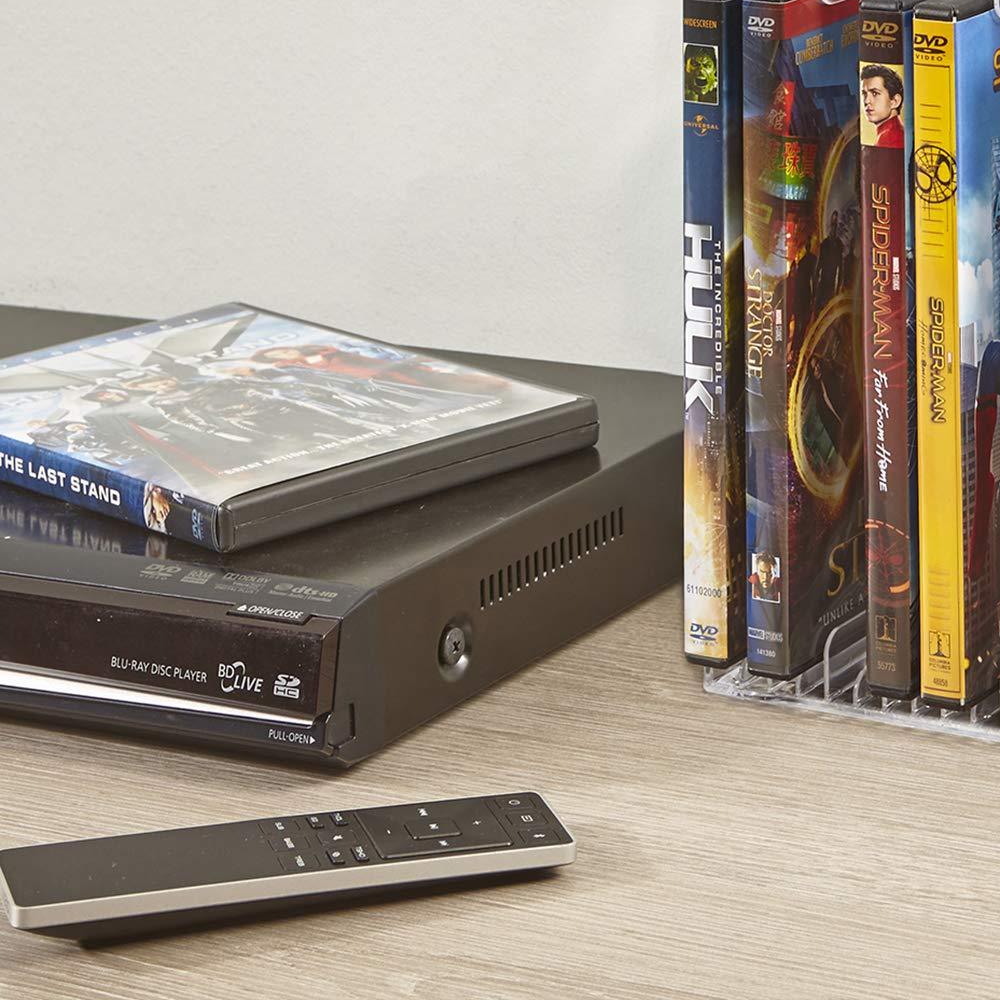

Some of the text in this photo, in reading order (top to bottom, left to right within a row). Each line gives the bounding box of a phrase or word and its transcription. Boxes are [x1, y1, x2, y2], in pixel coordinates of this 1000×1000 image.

[684, 18, 717, 29] WIDESCREEN
[748, 16, 775, 26] DVD
[862, 21, 899, 34] DVD
[865, 41, 893, 49] VIDEO
[914, 34, 947, 47] DVD
[871, 184, 892, 359] SPIDER-MAN
[684, 222, 713, 415] HULK
[747, 268, 763, 379] STRANGE
[762, 291, 773, 357] DOCTOR
[715, 283, 723, 395] INCREDIBLE
[928, 297, 946, 424] SPIDER-MAN
[29, 462, 66, 487] LAST
[70, 476, 120, 506] STAND
[145, 564, 182, 573] DVD
[687, 583, 722, 598] 61102000
[249, 605, 304, 619] OPEN/CLOSE
[690, 623, 718, 635] DVD
[110, 656, 207, 683] BLU-RAY DISC PLAYER
[218, 664, 234, 679] BD
[233, 676, 263, 693] LIVE
[268, 729, 308, 744] PULL-OPEN
